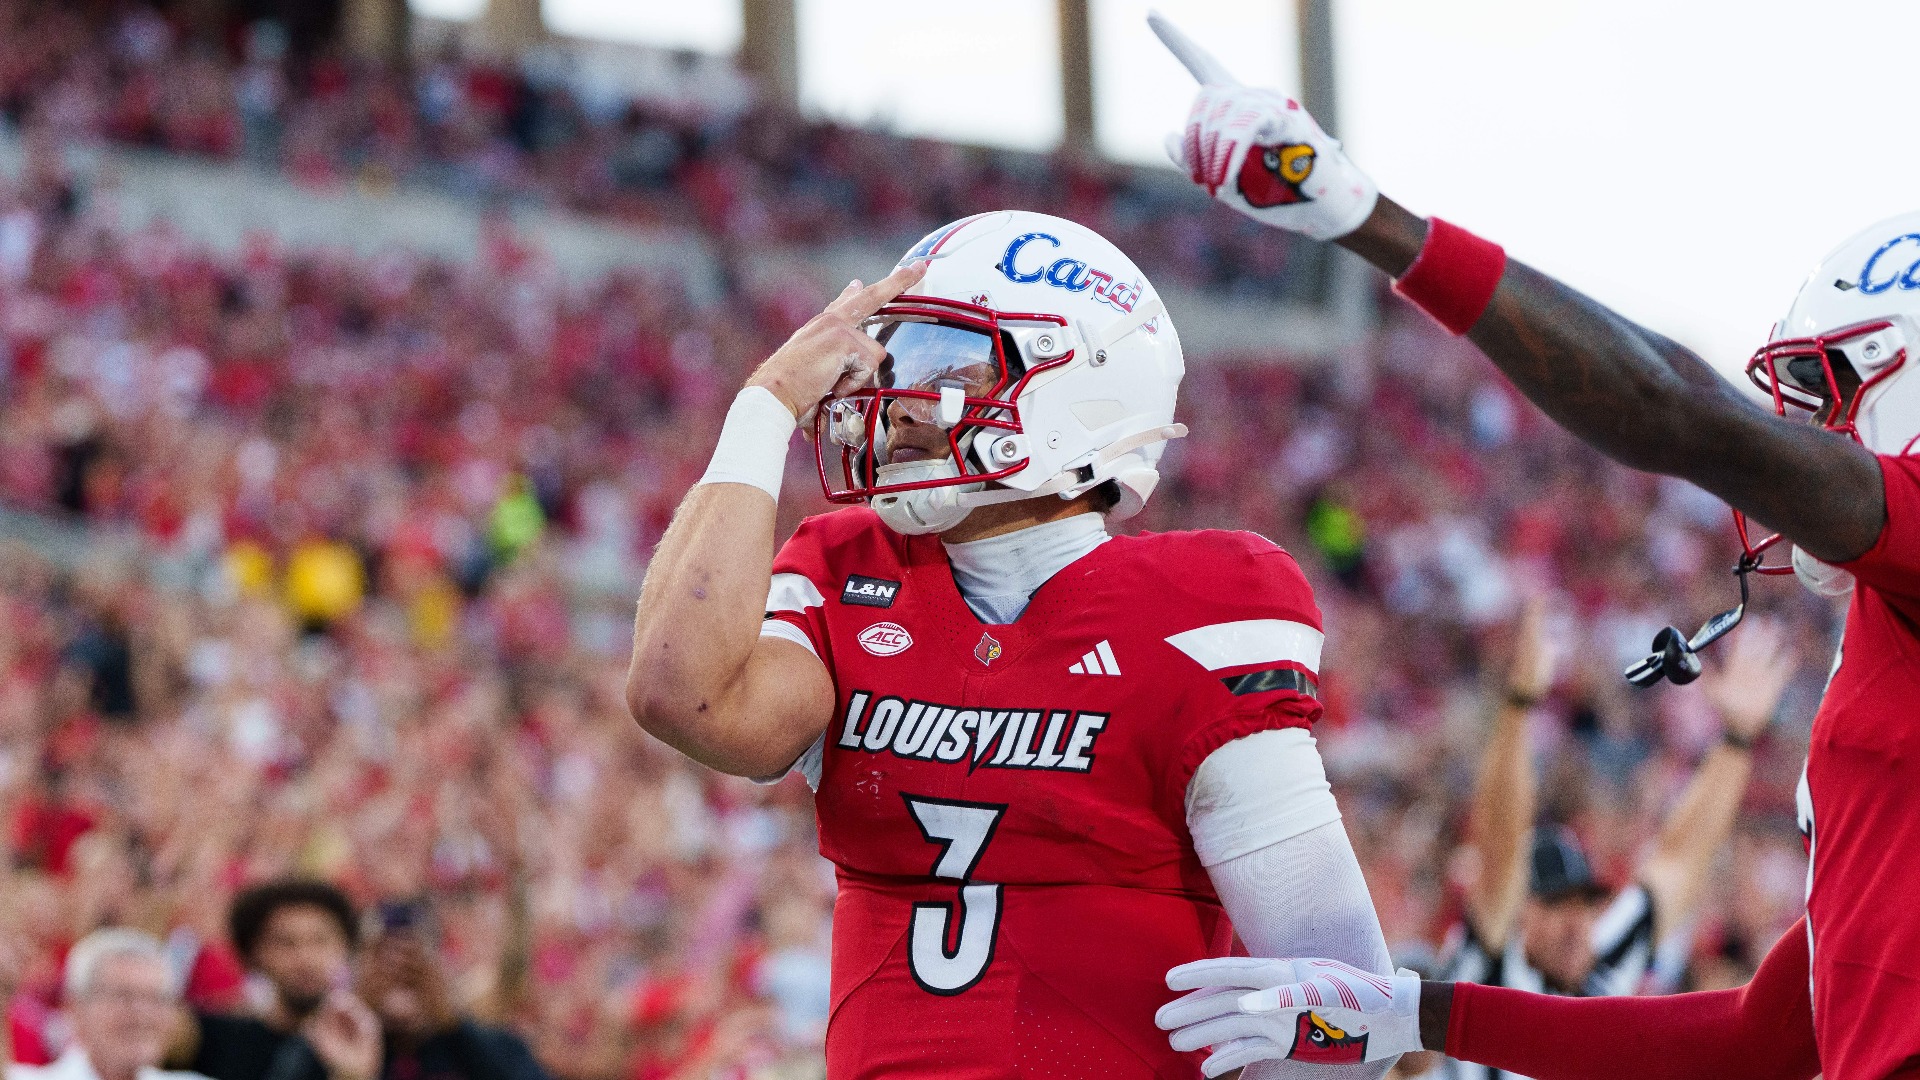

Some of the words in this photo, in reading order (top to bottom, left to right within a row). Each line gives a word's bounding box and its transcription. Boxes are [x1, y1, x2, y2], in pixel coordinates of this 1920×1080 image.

[845, 580, 896, 598] L&N
[866, 630, 906, 645] ACC
[838, 689, 1111, 775] LOUISVILLE
[899, 791, 1009, 996] 3
